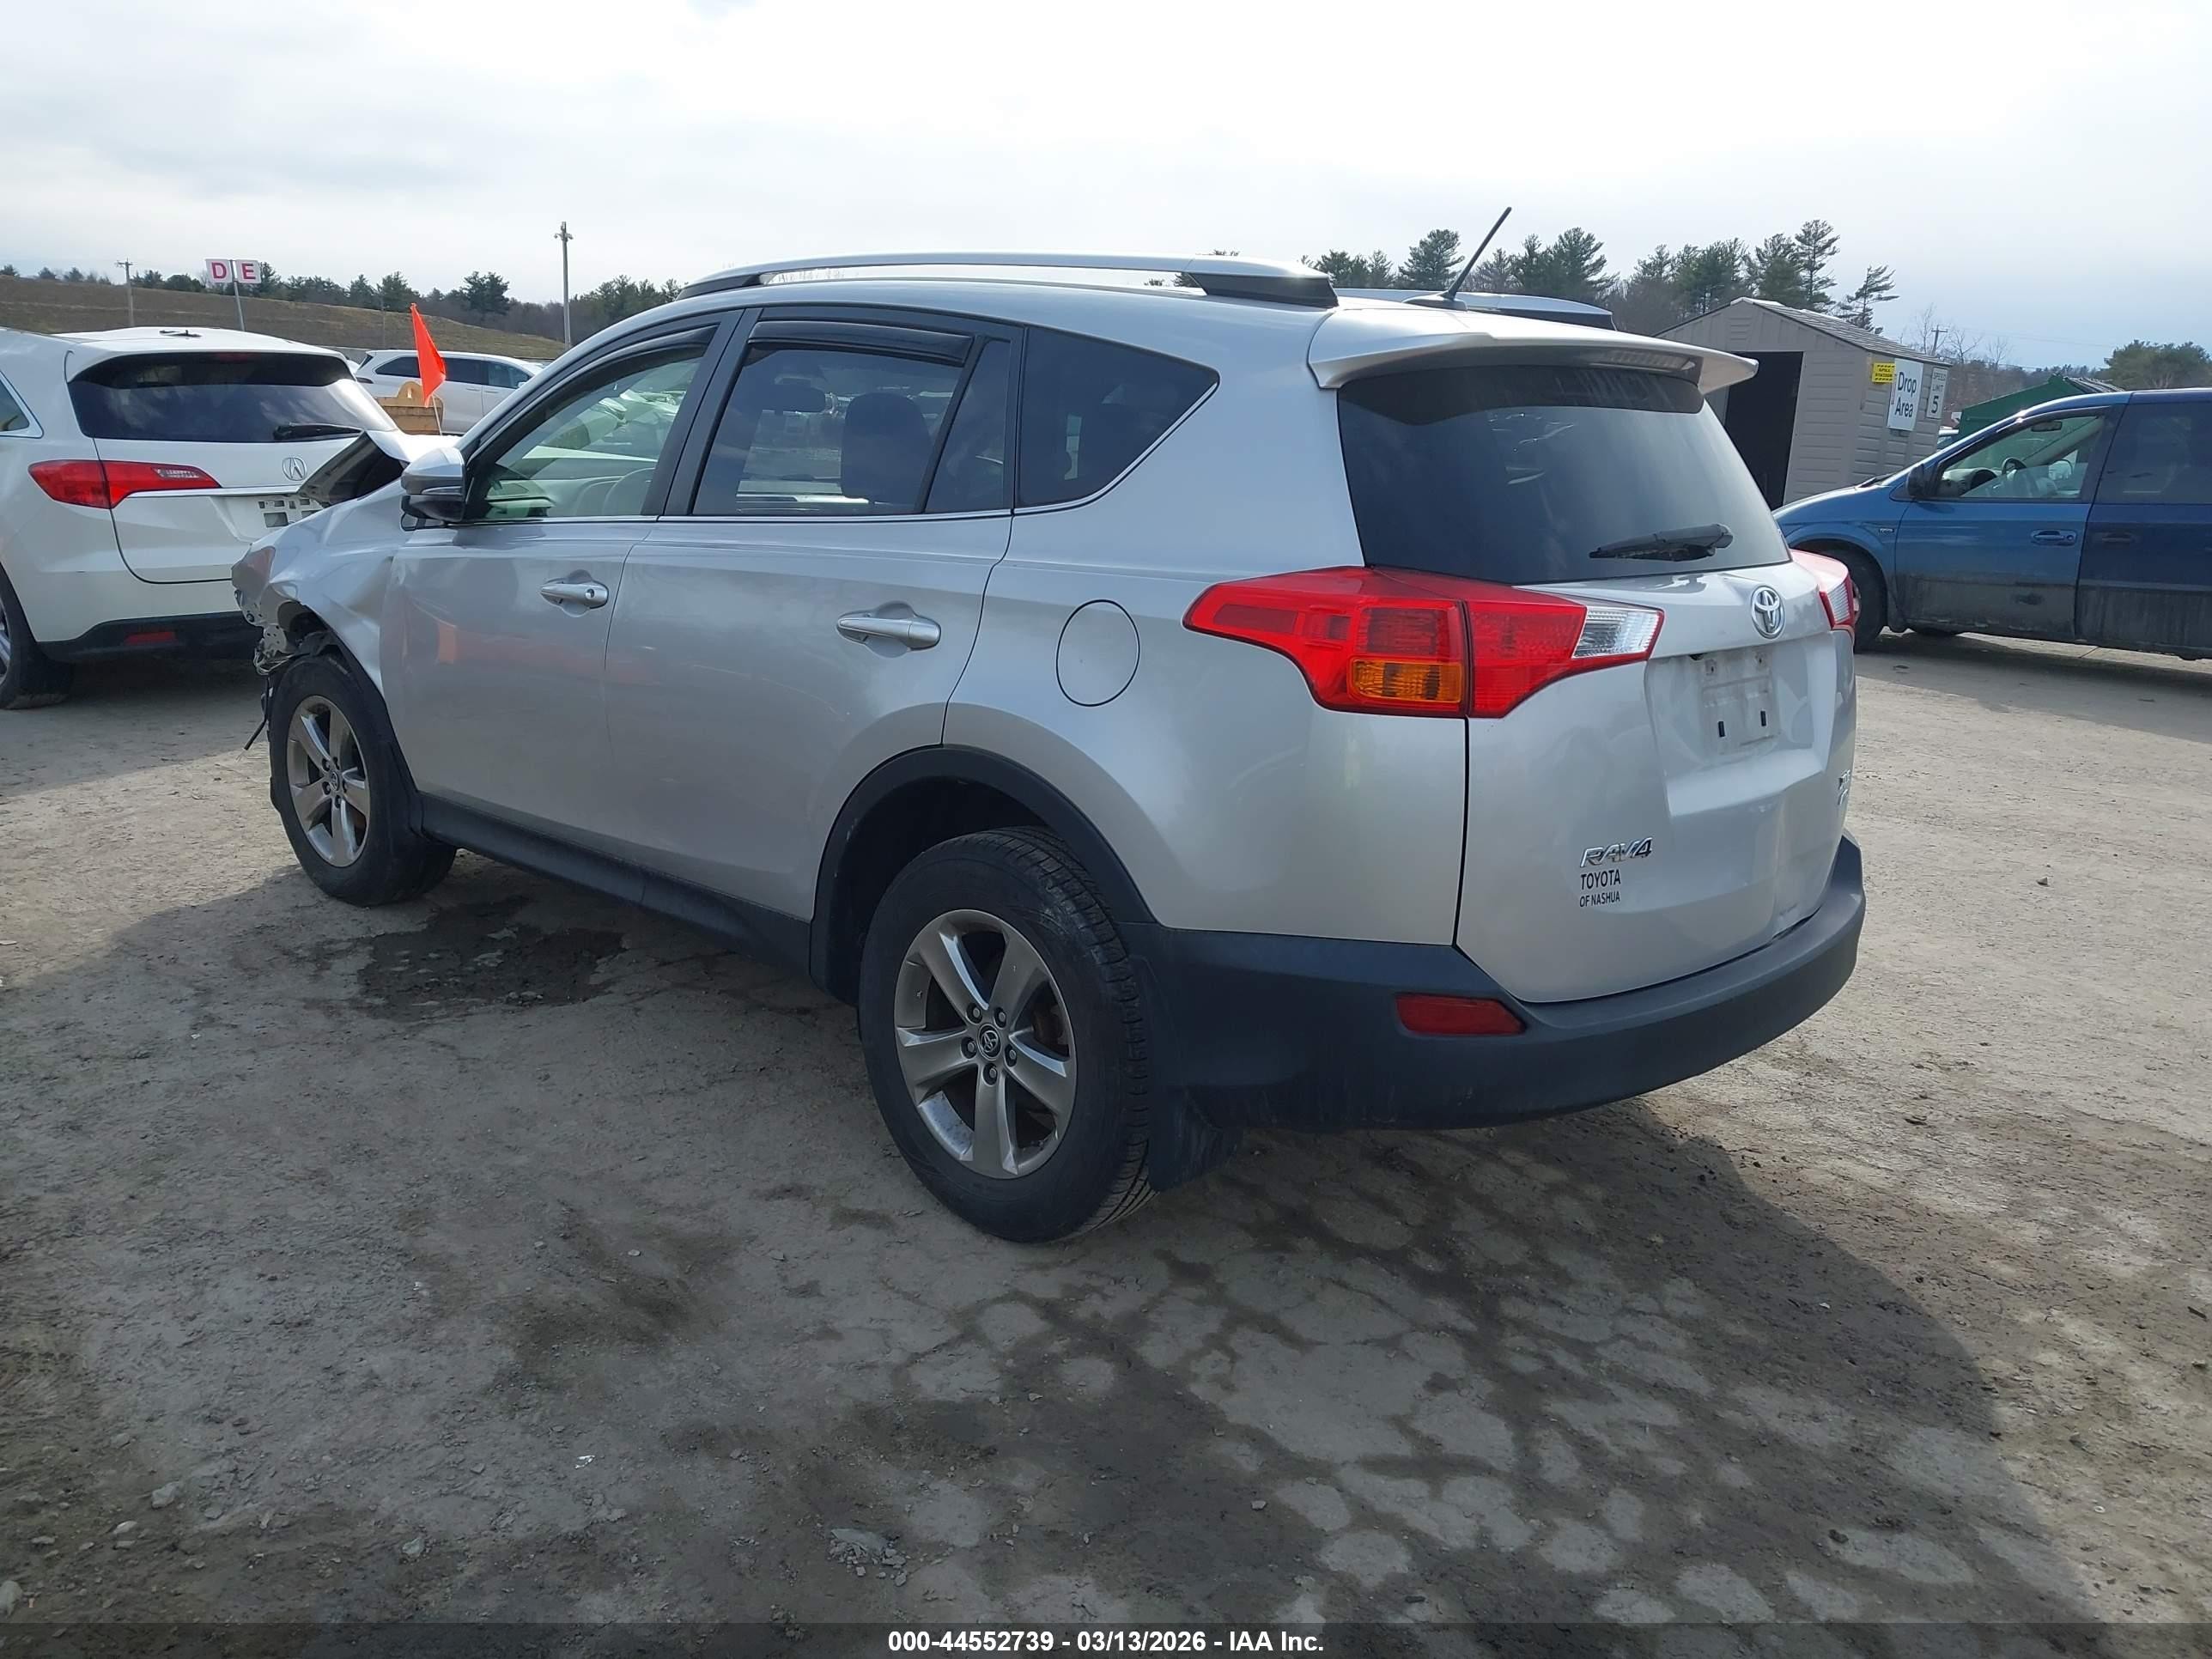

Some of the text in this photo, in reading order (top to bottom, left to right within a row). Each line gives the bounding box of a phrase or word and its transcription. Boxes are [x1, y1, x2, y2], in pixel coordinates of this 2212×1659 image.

[211, 262, 227, 279] D
[241, 263, 256, 280] E
[1898, 371, 1917, 398] Drop
[1894, 397, 1914, 418] Area
[1930, 395, 1939, 414] 5
[1580, 837, 1652, 868] RAV4
[1580, 869, 1621, 890] TOYOTA
[1580, 890, 1620, 908] OF NASHUA
